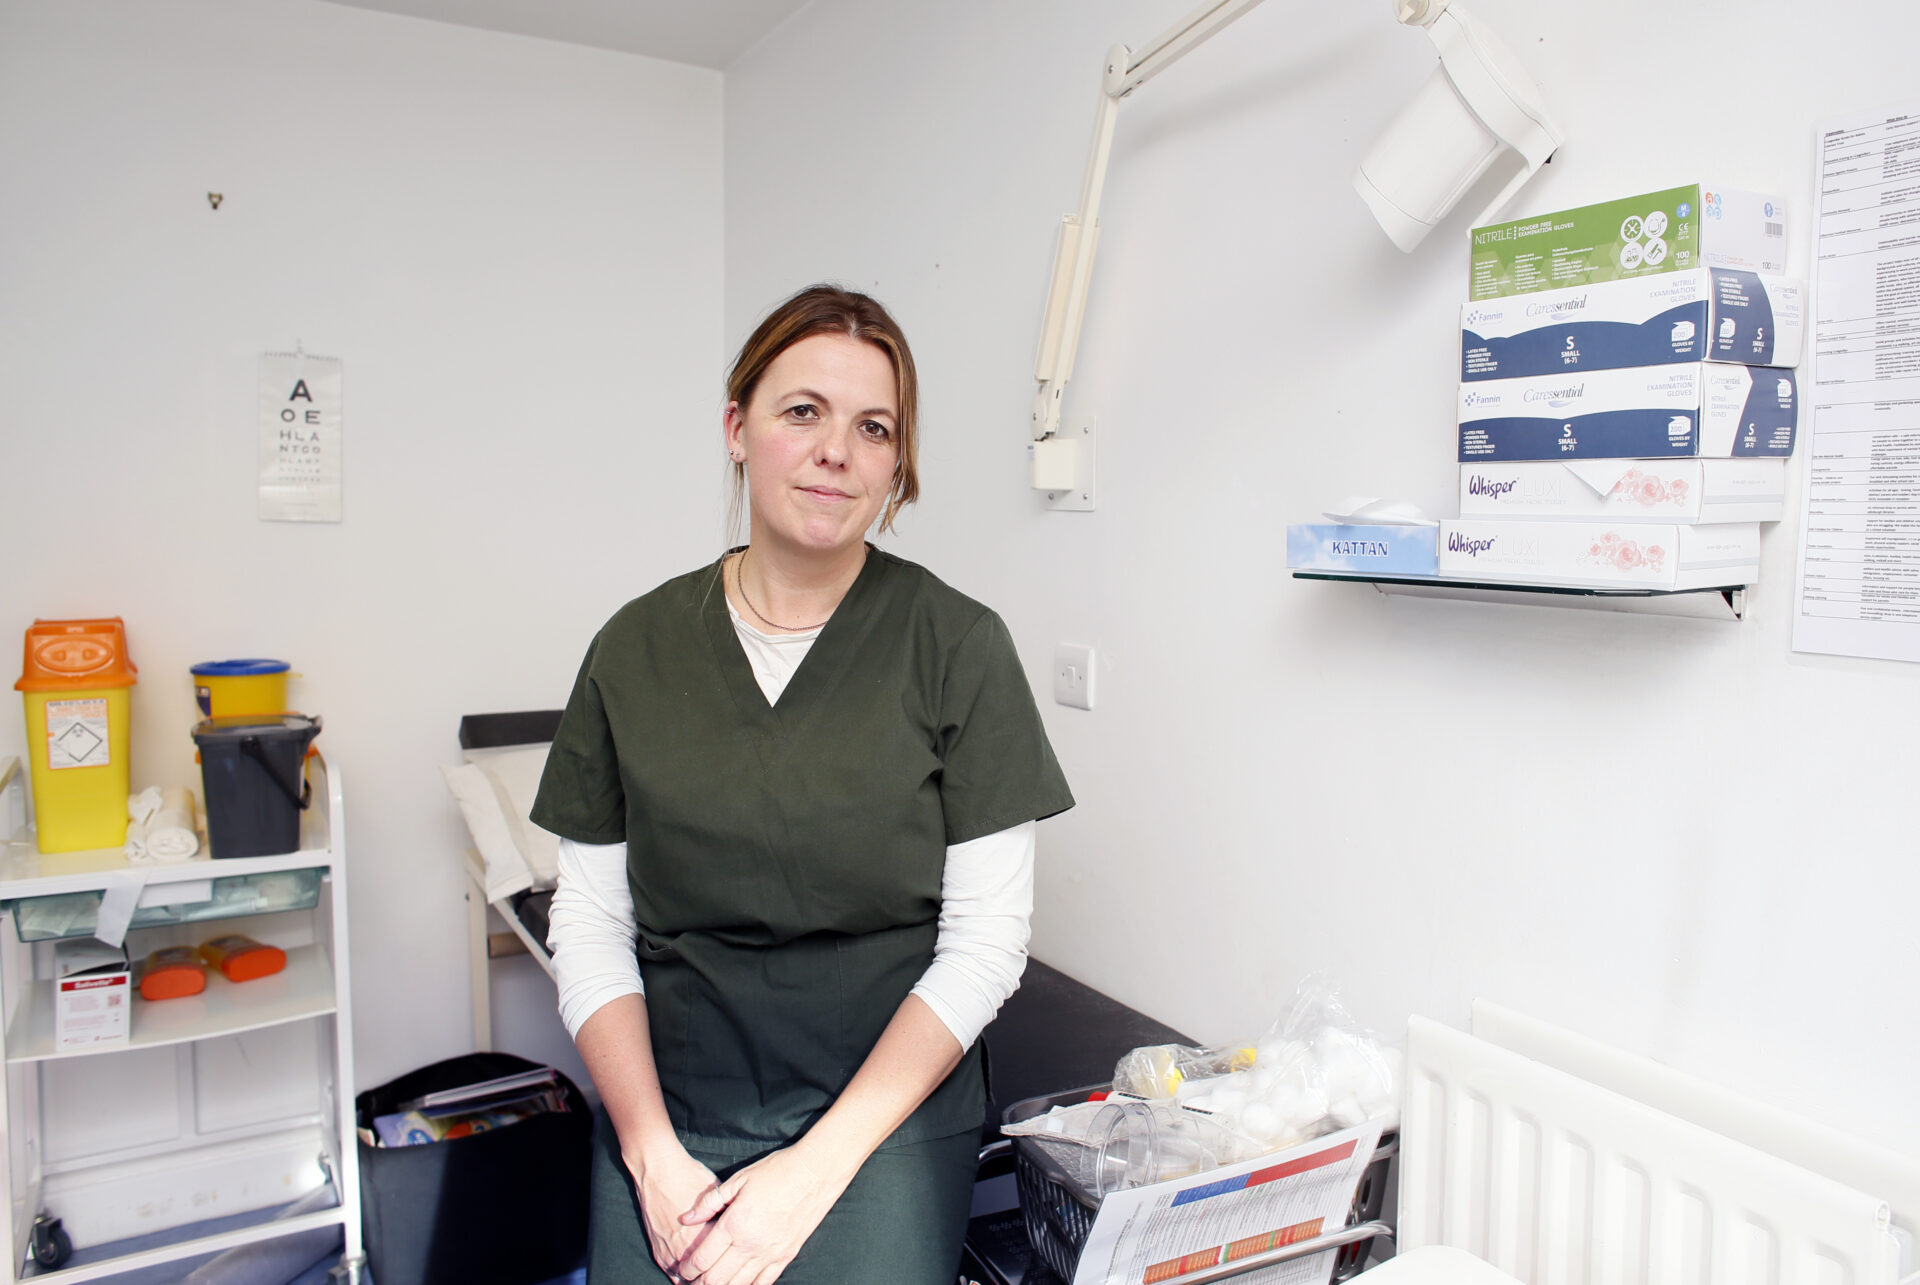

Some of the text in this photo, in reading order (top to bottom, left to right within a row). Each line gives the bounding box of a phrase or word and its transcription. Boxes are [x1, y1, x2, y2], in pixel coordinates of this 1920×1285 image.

[1475, 228, 1512, 245] NITRILE
[1518, 223, 1539, 232] POWDER
[1518, 222, 1575, 238] EXAMINATION GLOVES
[1675, 251, 1690, 259] 100
[1762, 262, 1772, 270] 100
[1672, 278, 1696, 287] NITRILE
[1649, 286, 1696, 298] EXAMINATION
[1670, 294, 1696, 303] GLOVES
[1526, 294, 1587, 318] Caressential
[1478, 312, 1503, 322] Fannin
[1757, 327, 1763, 340] S
[1566, 336, 1575, 350] S
[1560, 350, 1581, 358] SMALL
[1564, 357, 1578, 365] (6-7)
[1669, 374, 1693, 382] NITRILE
[289, 378, 313, 403] A
[1647, 382, 1693, 391] EXAMINATION
[1476, 394, 1501, 404] Fannin
[1523, 383, 1585, 404] Caressential
[1563, 423, 1572, 438] S
[1748, 423, 1755, 435] S
[1561, 444, 1575, 452] (6-7)
[1469, 475, 1517, 500] Whisper
[1332, 541, 1389, 556] KATTAN
[1448, 532, 1495, 557] Whisper
